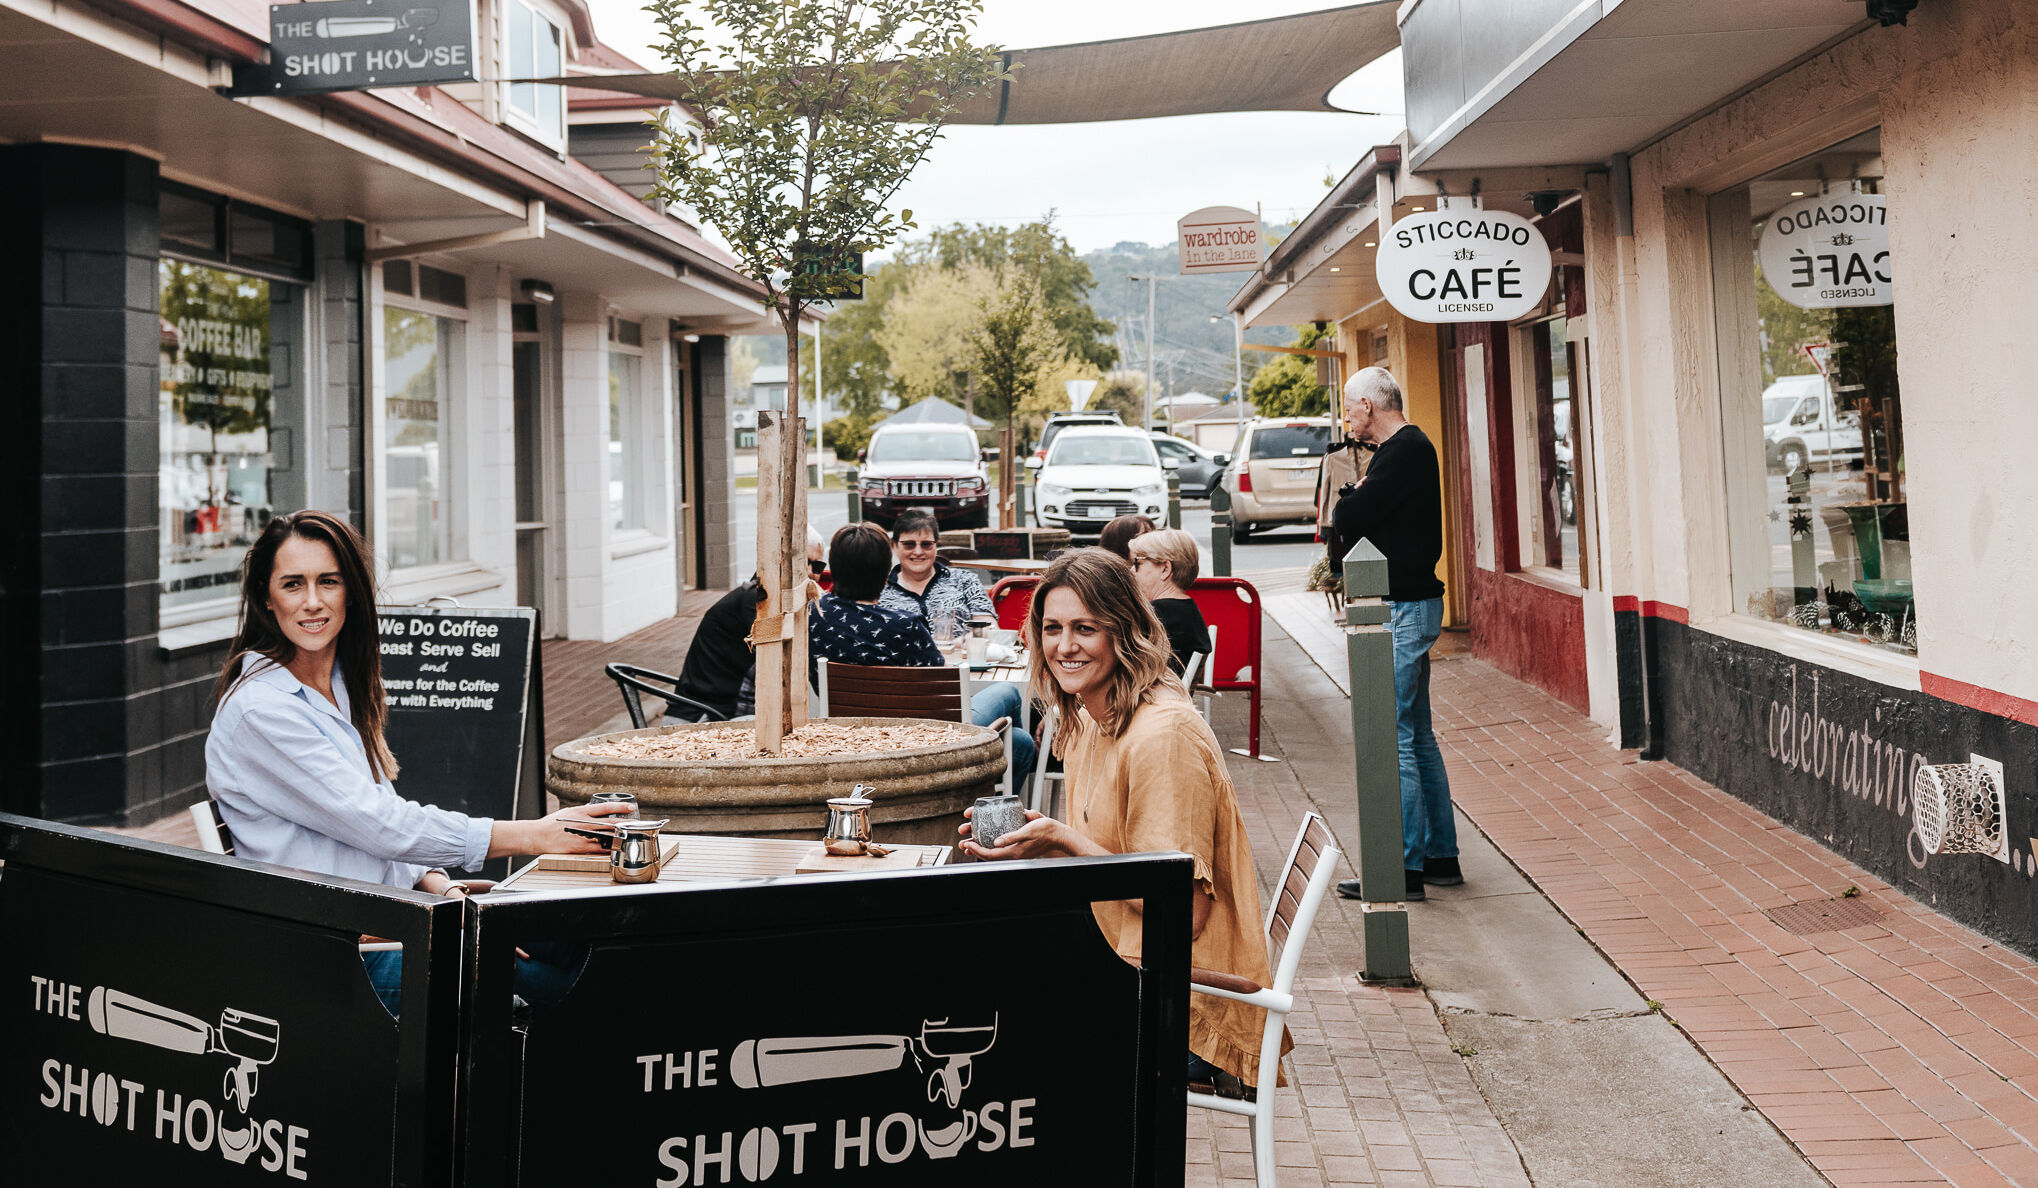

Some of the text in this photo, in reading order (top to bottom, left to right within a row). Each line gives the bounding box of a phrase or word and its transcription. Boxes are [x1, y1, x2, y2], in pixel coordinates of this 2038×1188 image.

[275, 21, 313, 39] THE
[284, 51, 357, 76] SHOT
[1183, 226, 1257, 248] wardrobe
[1396, 220, 1531, 249] STICCADO
[1186, 247, 1257, 263] in the lane
[1408, 259, 1523, 300] CAFÉ
[1438, 303, 1494, 313] LICENSED
[177, 317, 261, 360] COFFEE BAR
[377, 618, 499, 638] We Do Coffee
[379, 641, 501, 657] oast Serve Sell
[419, 661, 449, 673] and
[382, 677, 500, 692] ware for the Coffee
[384, 694, 494, 711] er with Everything
[31, 975, 82, 1021] THE
[636, 1049, 719, 1093] THE
[40, 1058, 145, 1132] SHOT
[656, 1122, 817, 1188] SHOT
